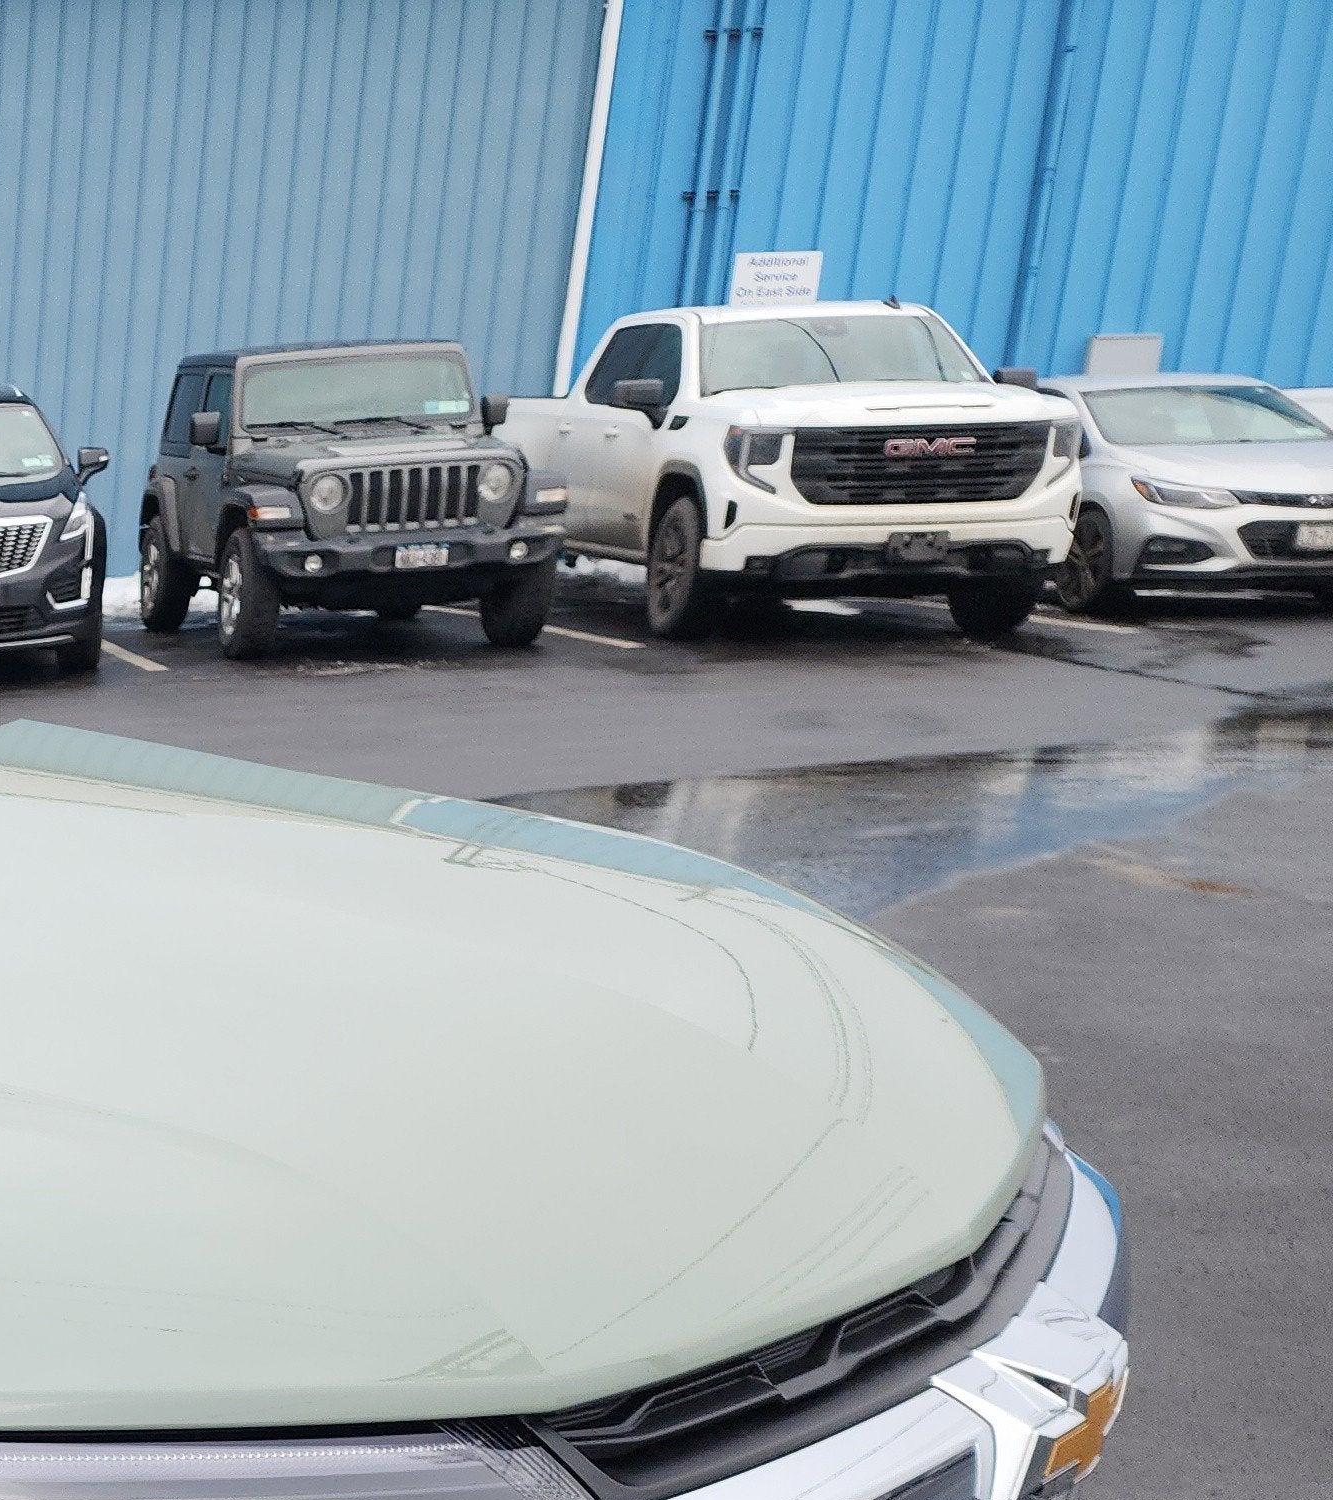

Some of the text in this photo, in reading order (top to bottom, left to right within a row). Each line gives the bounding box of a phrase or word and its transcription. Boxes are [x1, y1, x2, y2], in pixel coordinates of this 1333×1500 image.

[747, 256, 810, 268] Additional
[753, 271, 799, 283] Service
[735, 285, 812, 298] On East Side
[884, 437, 977, 458] GMC
